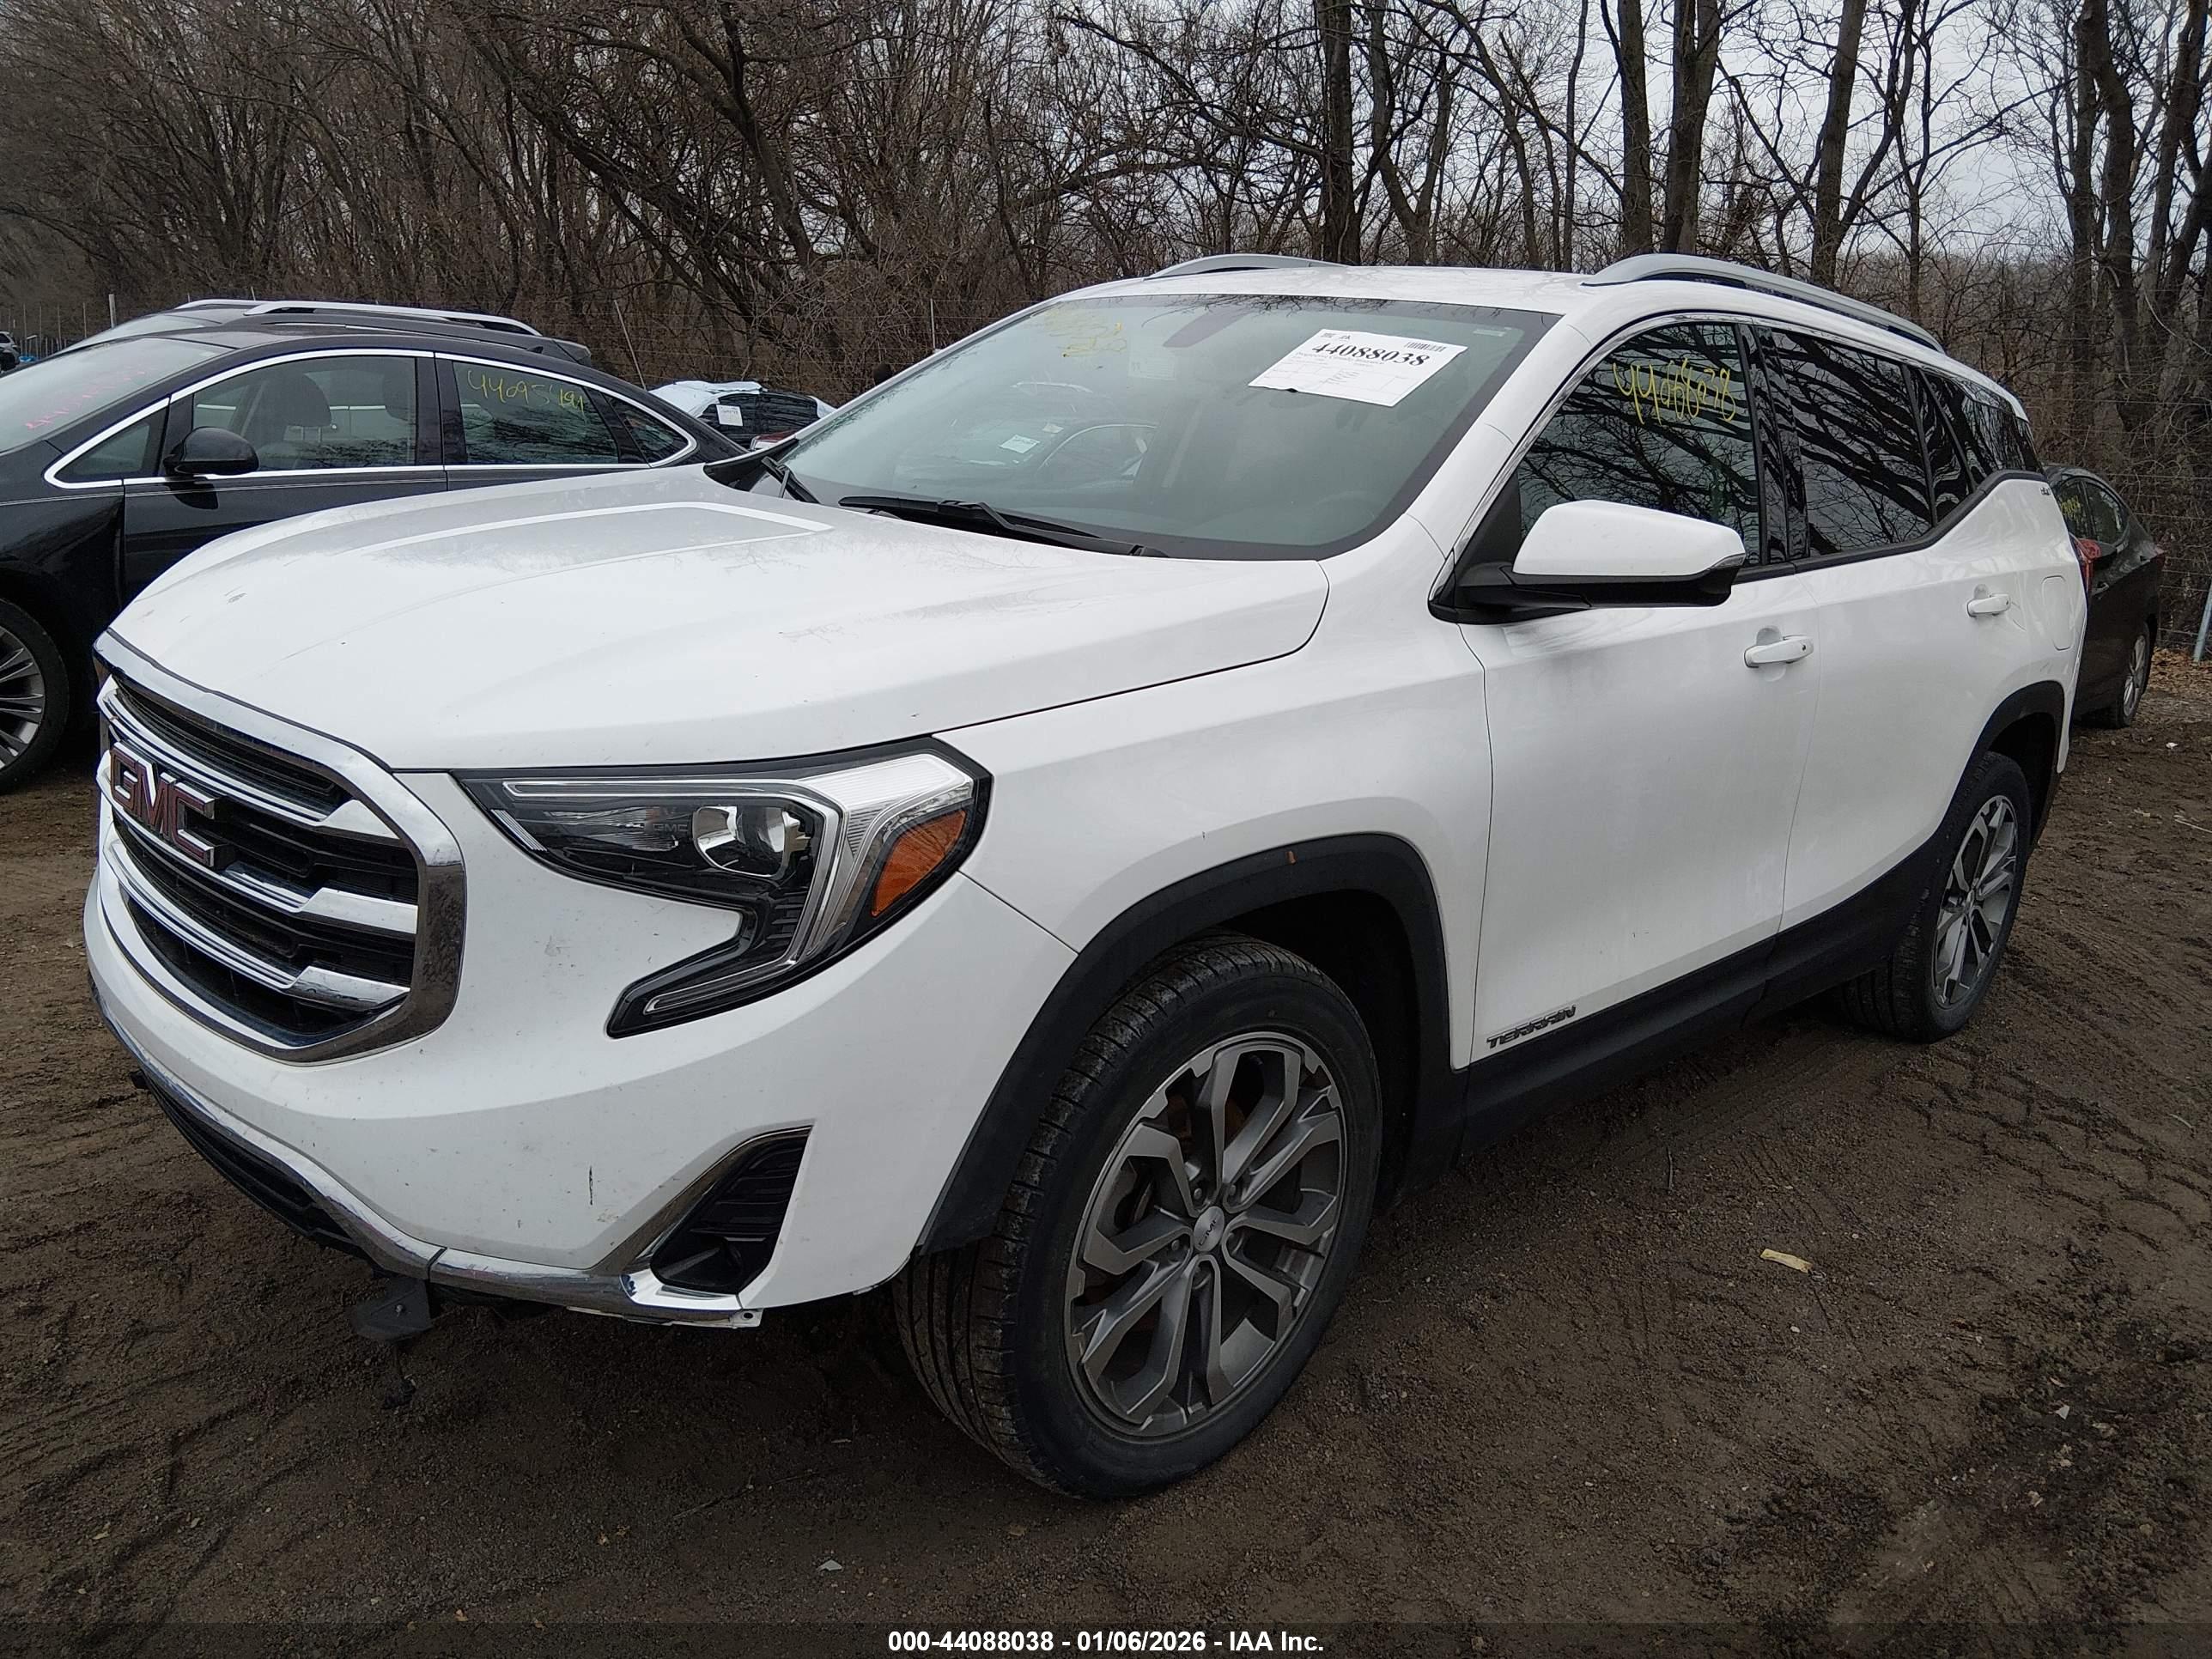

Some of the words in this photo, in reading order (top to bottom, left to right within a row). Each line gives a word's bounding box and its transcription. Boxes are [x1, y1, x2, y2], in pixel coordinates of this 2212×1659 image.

[1312, 343, 1431, 367] 44088038
[110, 741, 215, 867] GMC
[653, 823, 688, 832] GMC
[1486, 1004, 1577, 1048] TERRAIN
